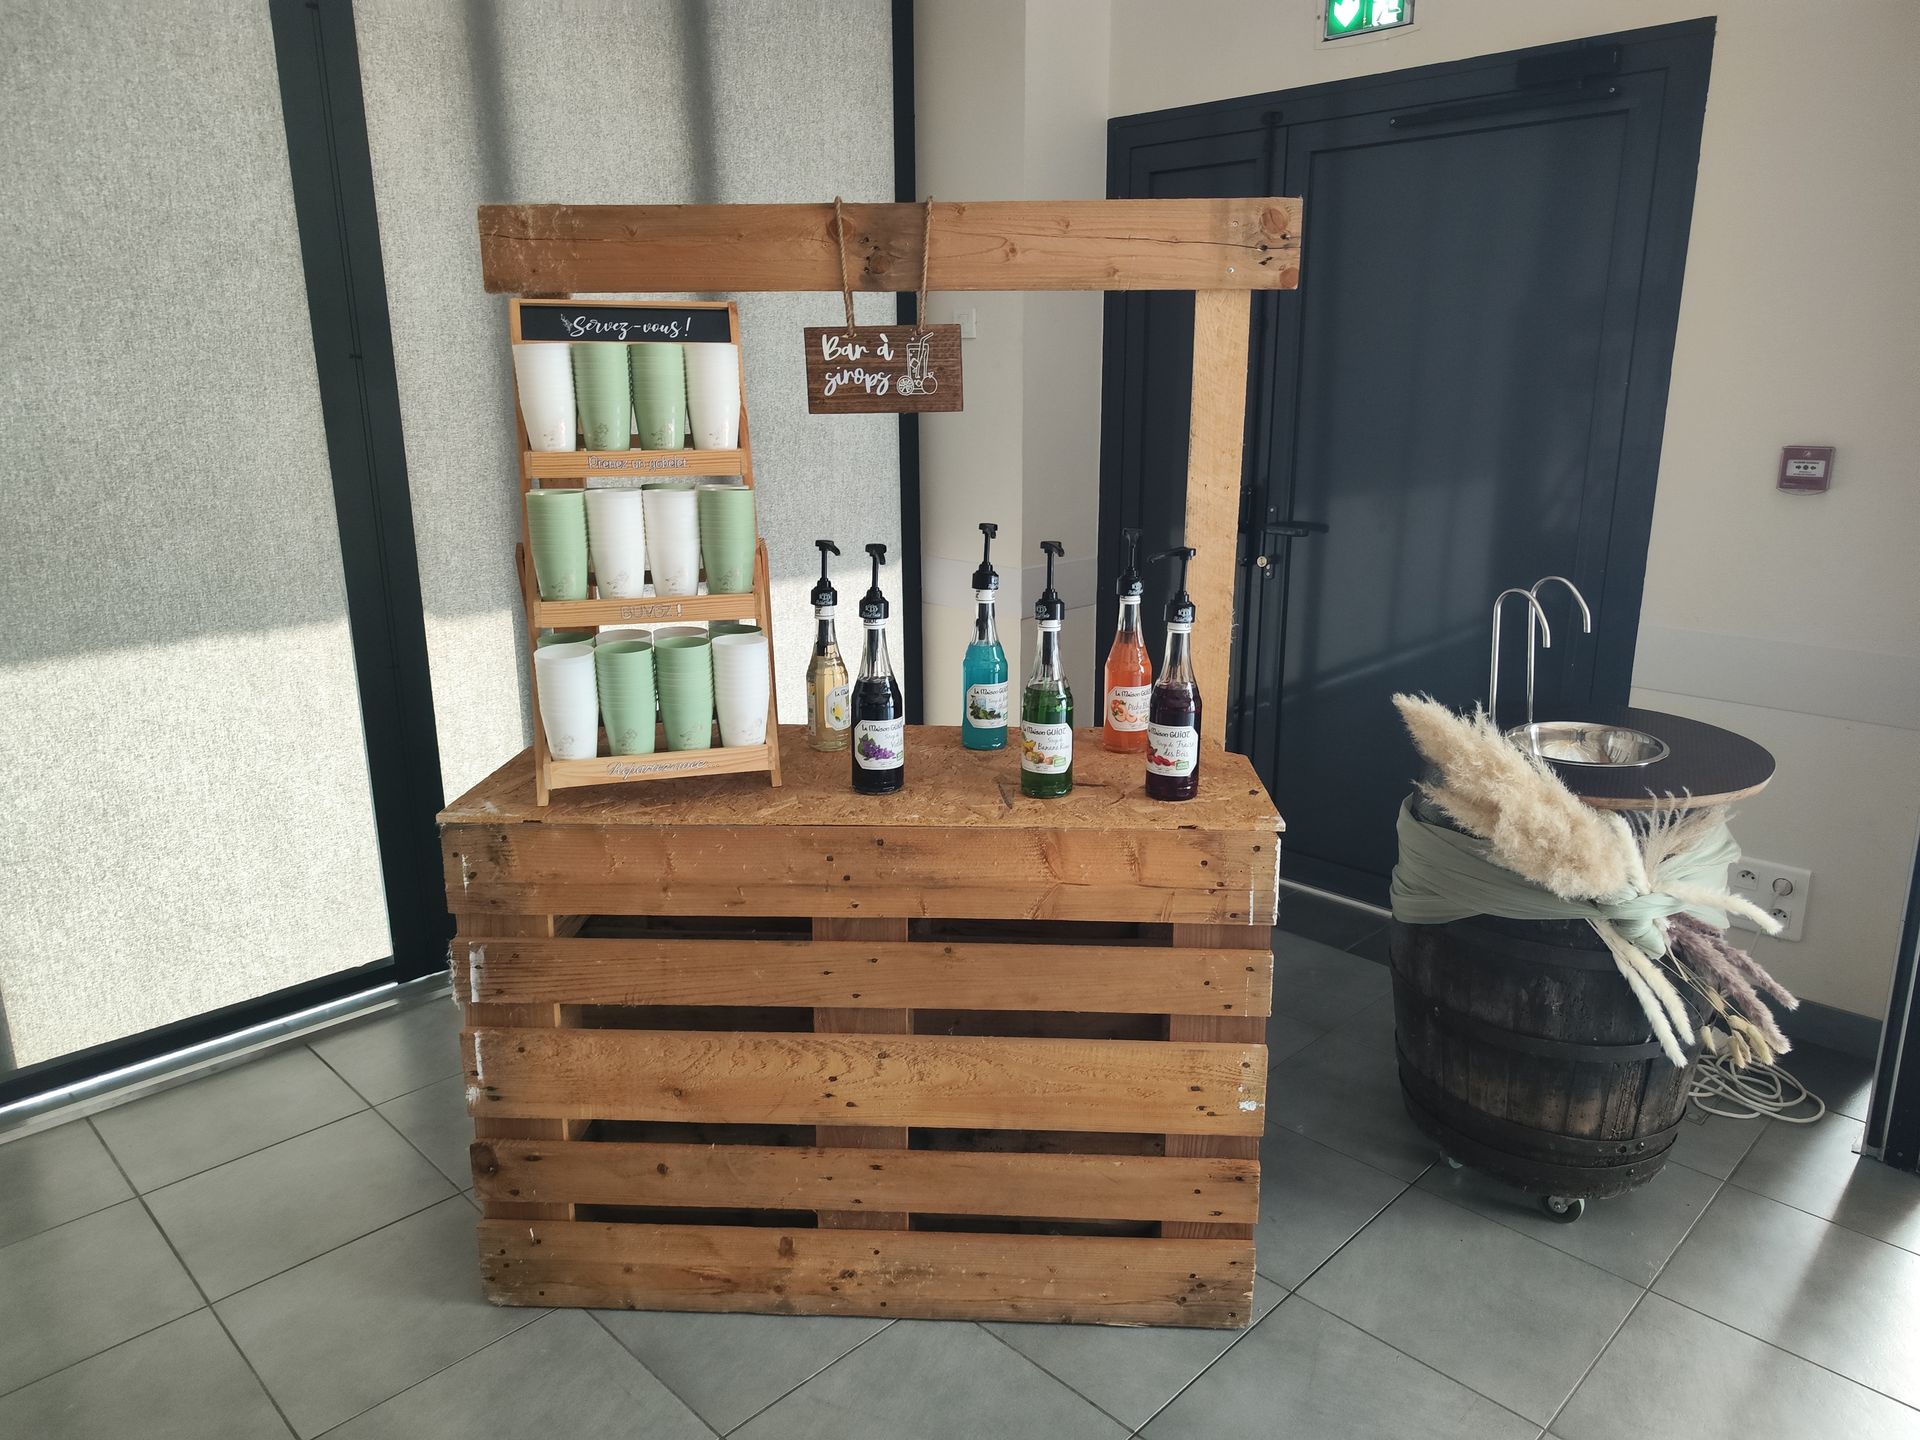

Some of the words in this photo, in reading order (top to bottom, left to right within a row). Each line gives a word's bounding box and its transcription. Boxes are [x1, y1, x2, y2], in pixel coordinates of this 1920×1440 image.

[821, 333, 870, 361] Bar
[876, 333, 895, 361] à
[823, 366, 892, 397] sirops
[588, 455, 628, 470] Prenez
[649, 455, 688, 473] gobelet
[868, 724, 889, 734] Maison
[1027, 726, 1046, 736] Maison
